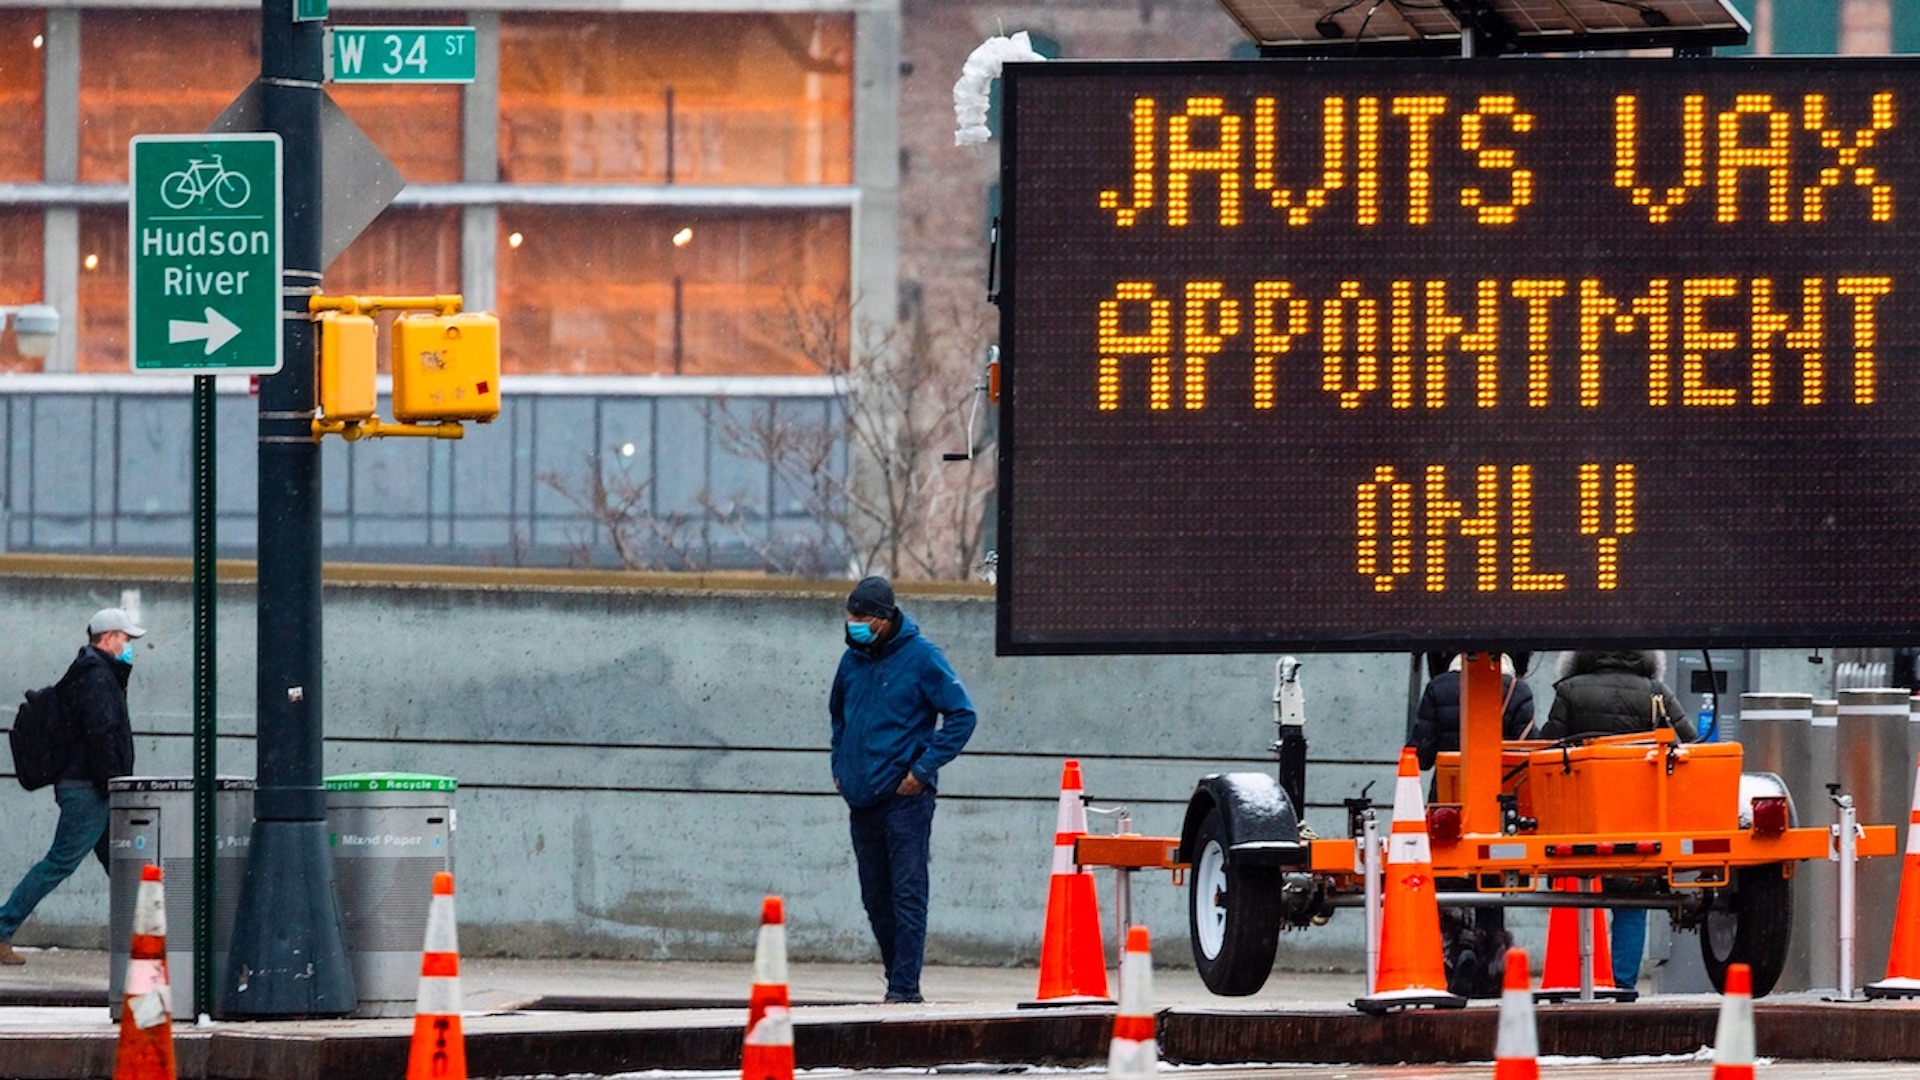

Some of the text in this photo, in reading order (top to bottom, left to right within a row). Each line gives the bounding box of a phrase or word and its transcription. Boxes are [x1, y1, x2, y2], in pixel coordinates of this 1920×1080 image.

[338, 34, 466, 75] W 34 ST
[1099, 92, 1893, 228] JAVITS VAX
[142, 225, 269, 256] Hudson
[164, 264, 250, 296] River
[1097, 276, 1891, 411] APPOINTMENT
[1356, 463, 1635, 593] ONLY
[324, 780, 432, 791] ecycle Recycle
[342, 834, 422, 847] Mixed Paper
